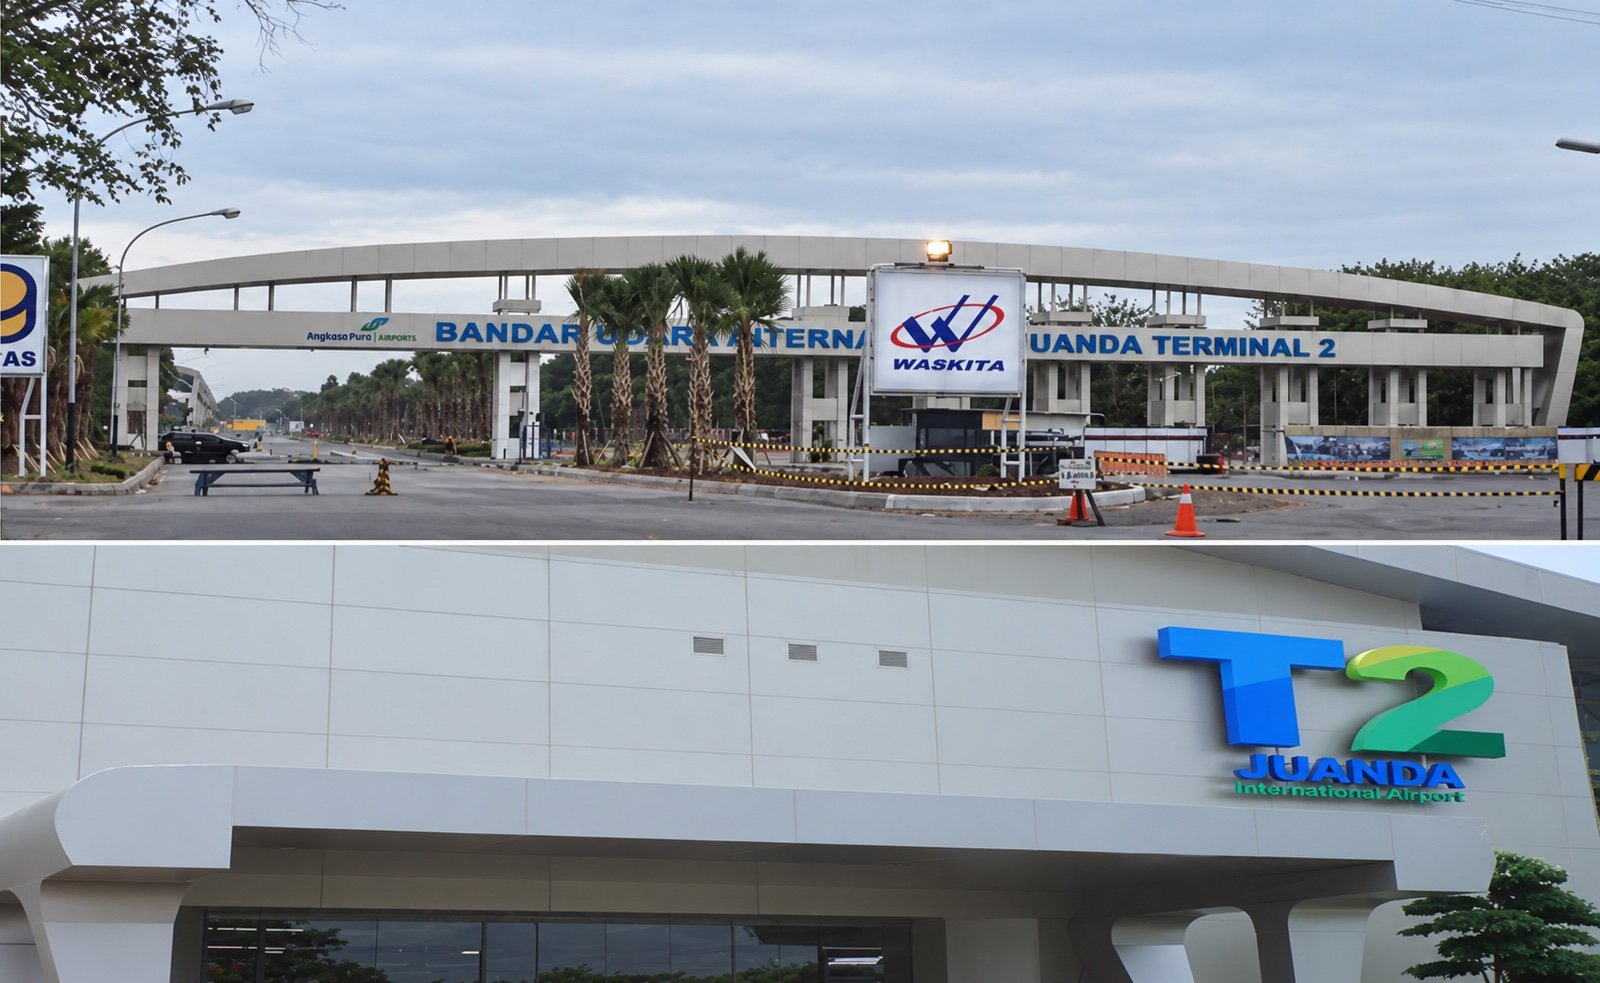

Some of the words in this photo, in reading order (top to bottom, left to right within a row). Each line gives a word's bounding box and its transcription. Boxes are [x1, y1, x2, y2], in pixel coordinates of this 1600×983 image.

[306, 331, 348, 343] Angkasa
[349, 332, 372, 342] Pura
[378, 334, 417, 342] AIRPORTS
[435, 321, 582, 344] BANDAR
[1152, 335, 1310, 358] TERMINAL
[1317, 338, 1337, 358] 2
[0, 350, 36, 367] AS
[893, 358, 1006, 372] WASKITA
[1157, 626, 1506, 758] T2
[1232, 753, 1465, 788] JUANDA
[1235, 781, 1382, 800] International
[1387, 787, 1465, 804] Airport
